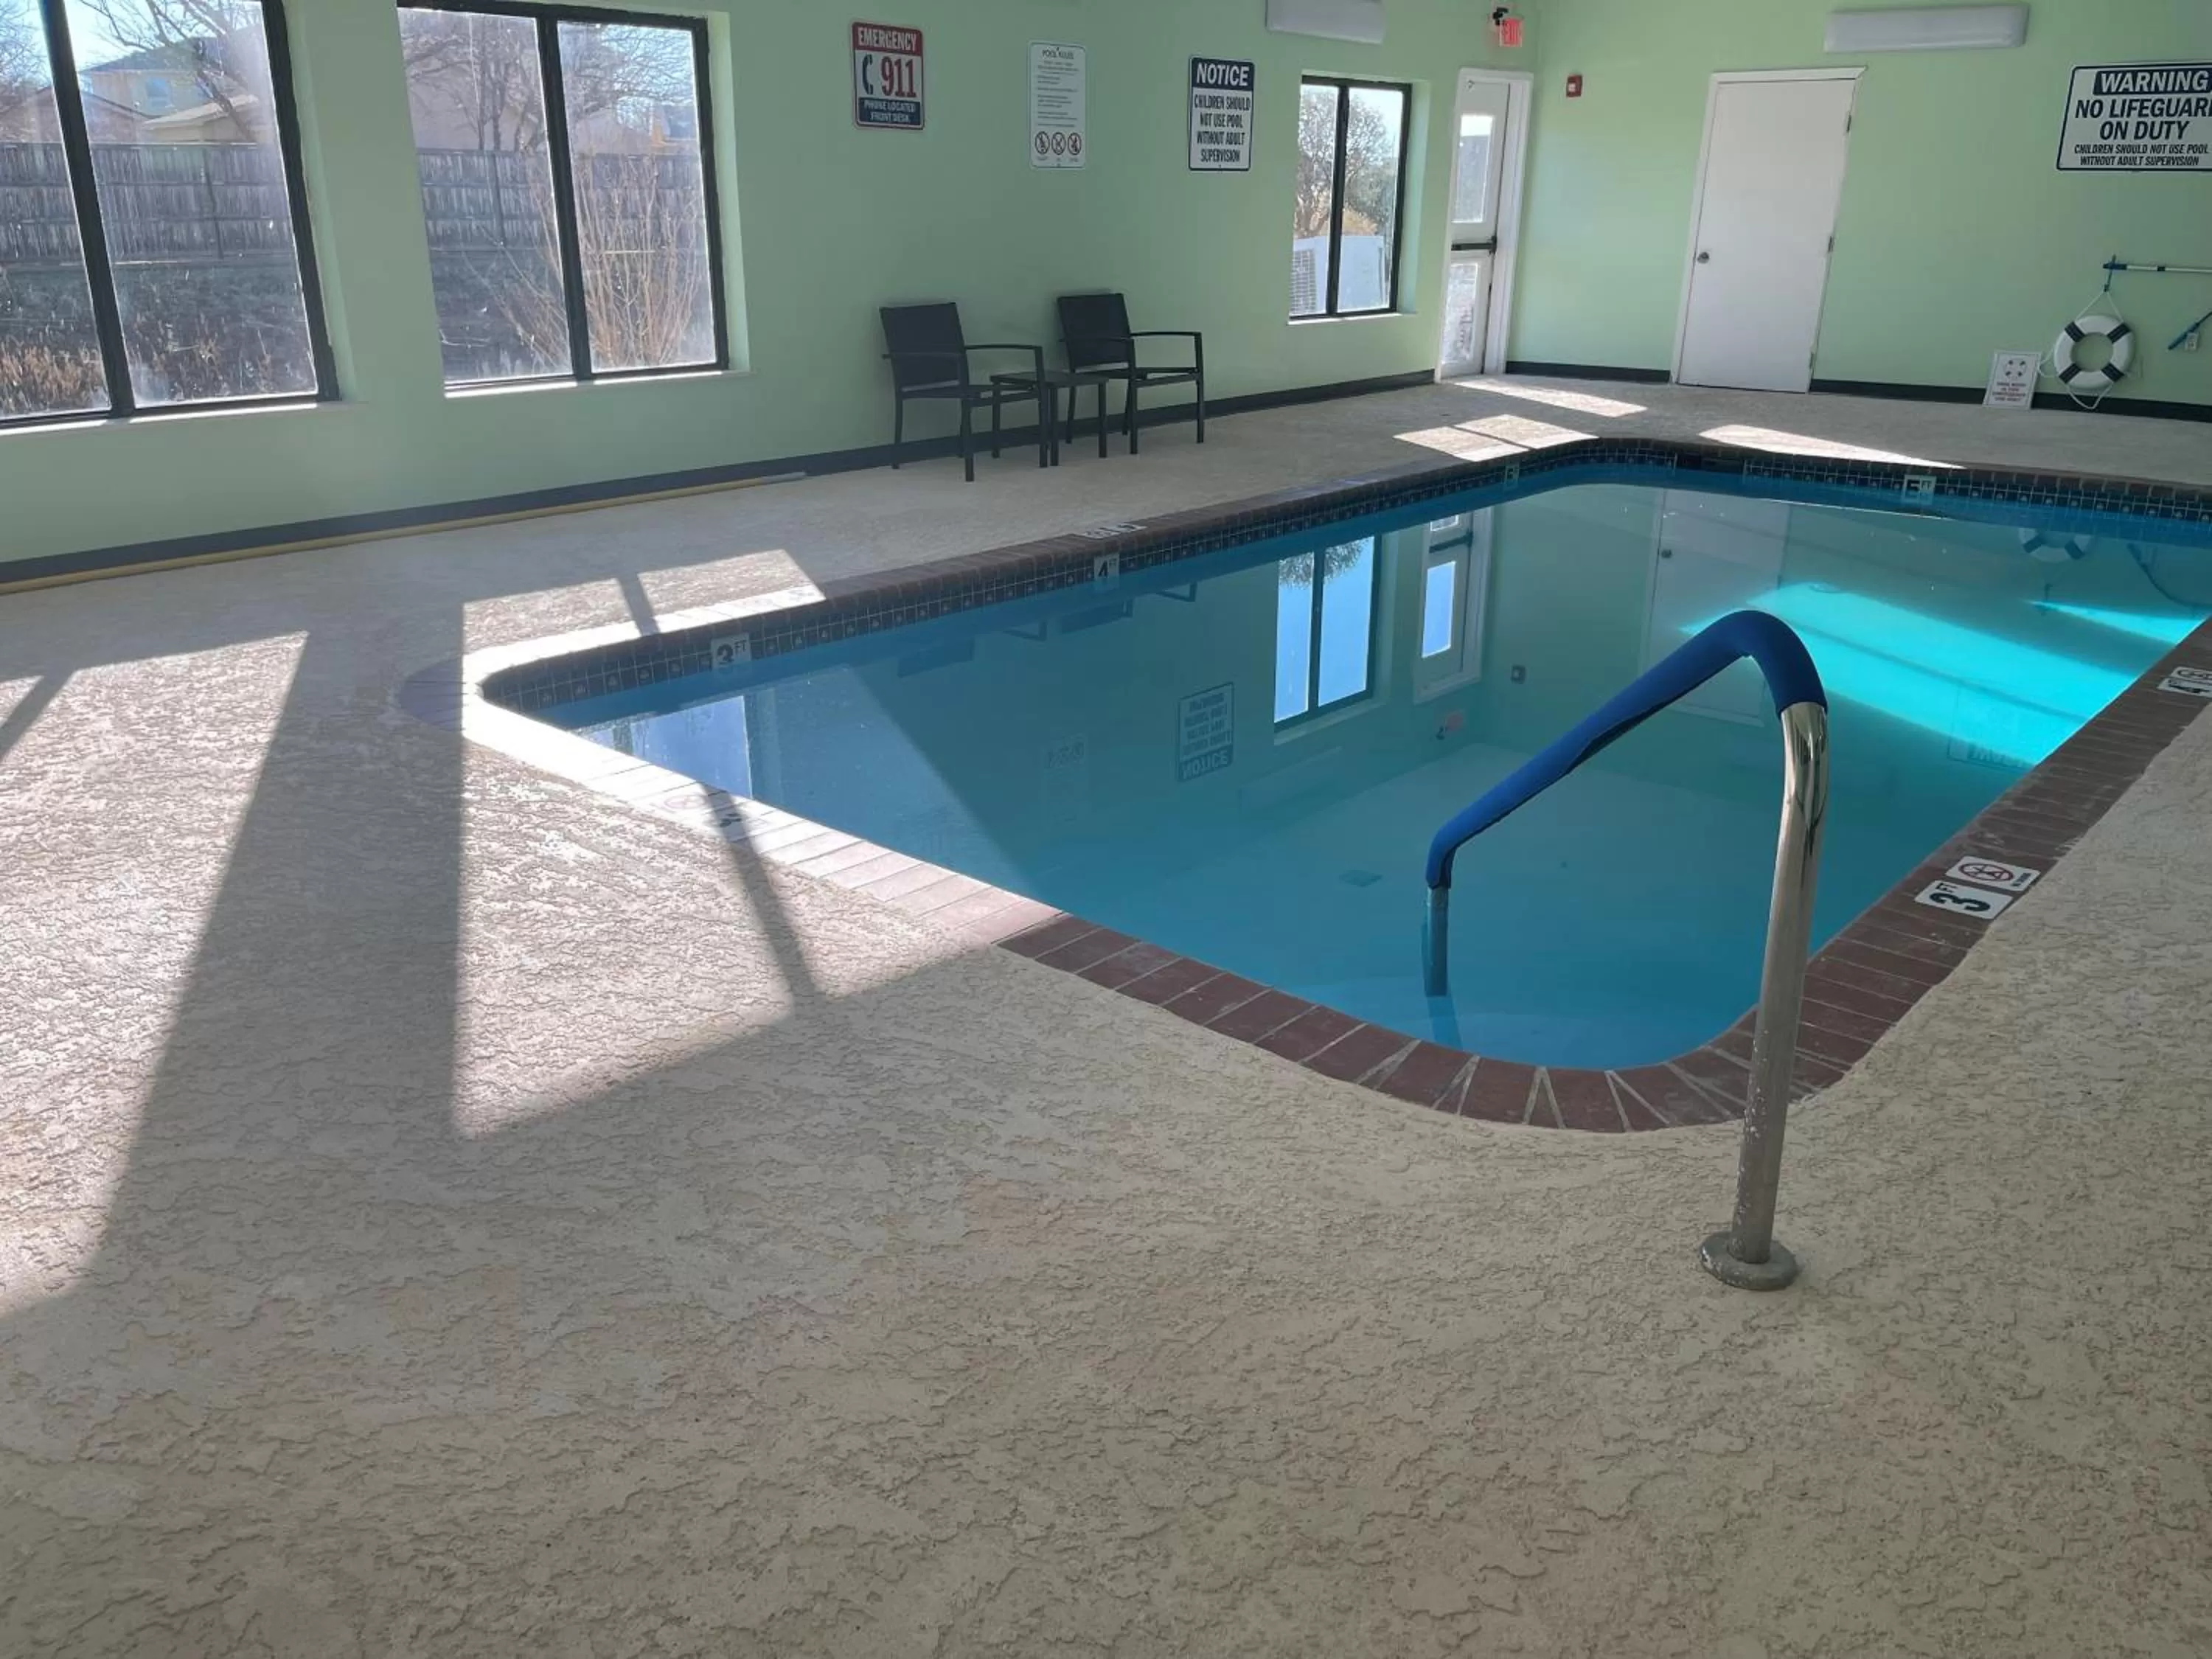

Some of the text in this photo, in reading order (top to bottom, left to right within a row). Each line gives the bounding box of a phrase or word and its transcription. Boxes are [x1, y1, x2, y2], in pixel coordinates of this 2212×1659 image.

[858, 27, 917, 52] EMERGENCY
[881, 56, 917, 97] 911
[1196, 63, 1250, 86] NOTICE
[2101, 70, 2209, 93] WARNING
[1194, 94, 1251, 111] CHILDREN SHOULD
[2075, 99, 2104, 119] NO
[1200, 113, 1243, 128] NOT USE POOL
[1197, 131, 1245, 145] WITHOUT ADULT
[2099, 120, 2191, 140] ON DUTY
[1200, 149, 1241, 163] SUPERVISION
[2074, 144, 2209, 154] CHILDREN SHOULD NOT USE POOL
[2080, 156, 2199, 166] WITHOUT ADULT SUPERVISION
[1907, 479, 1920, 493] 5
[1098, 560, 1109, 577] 4
[717, 639, 746, 663] 3 FT
[1929, 882, 1991, 912] 3 FT
